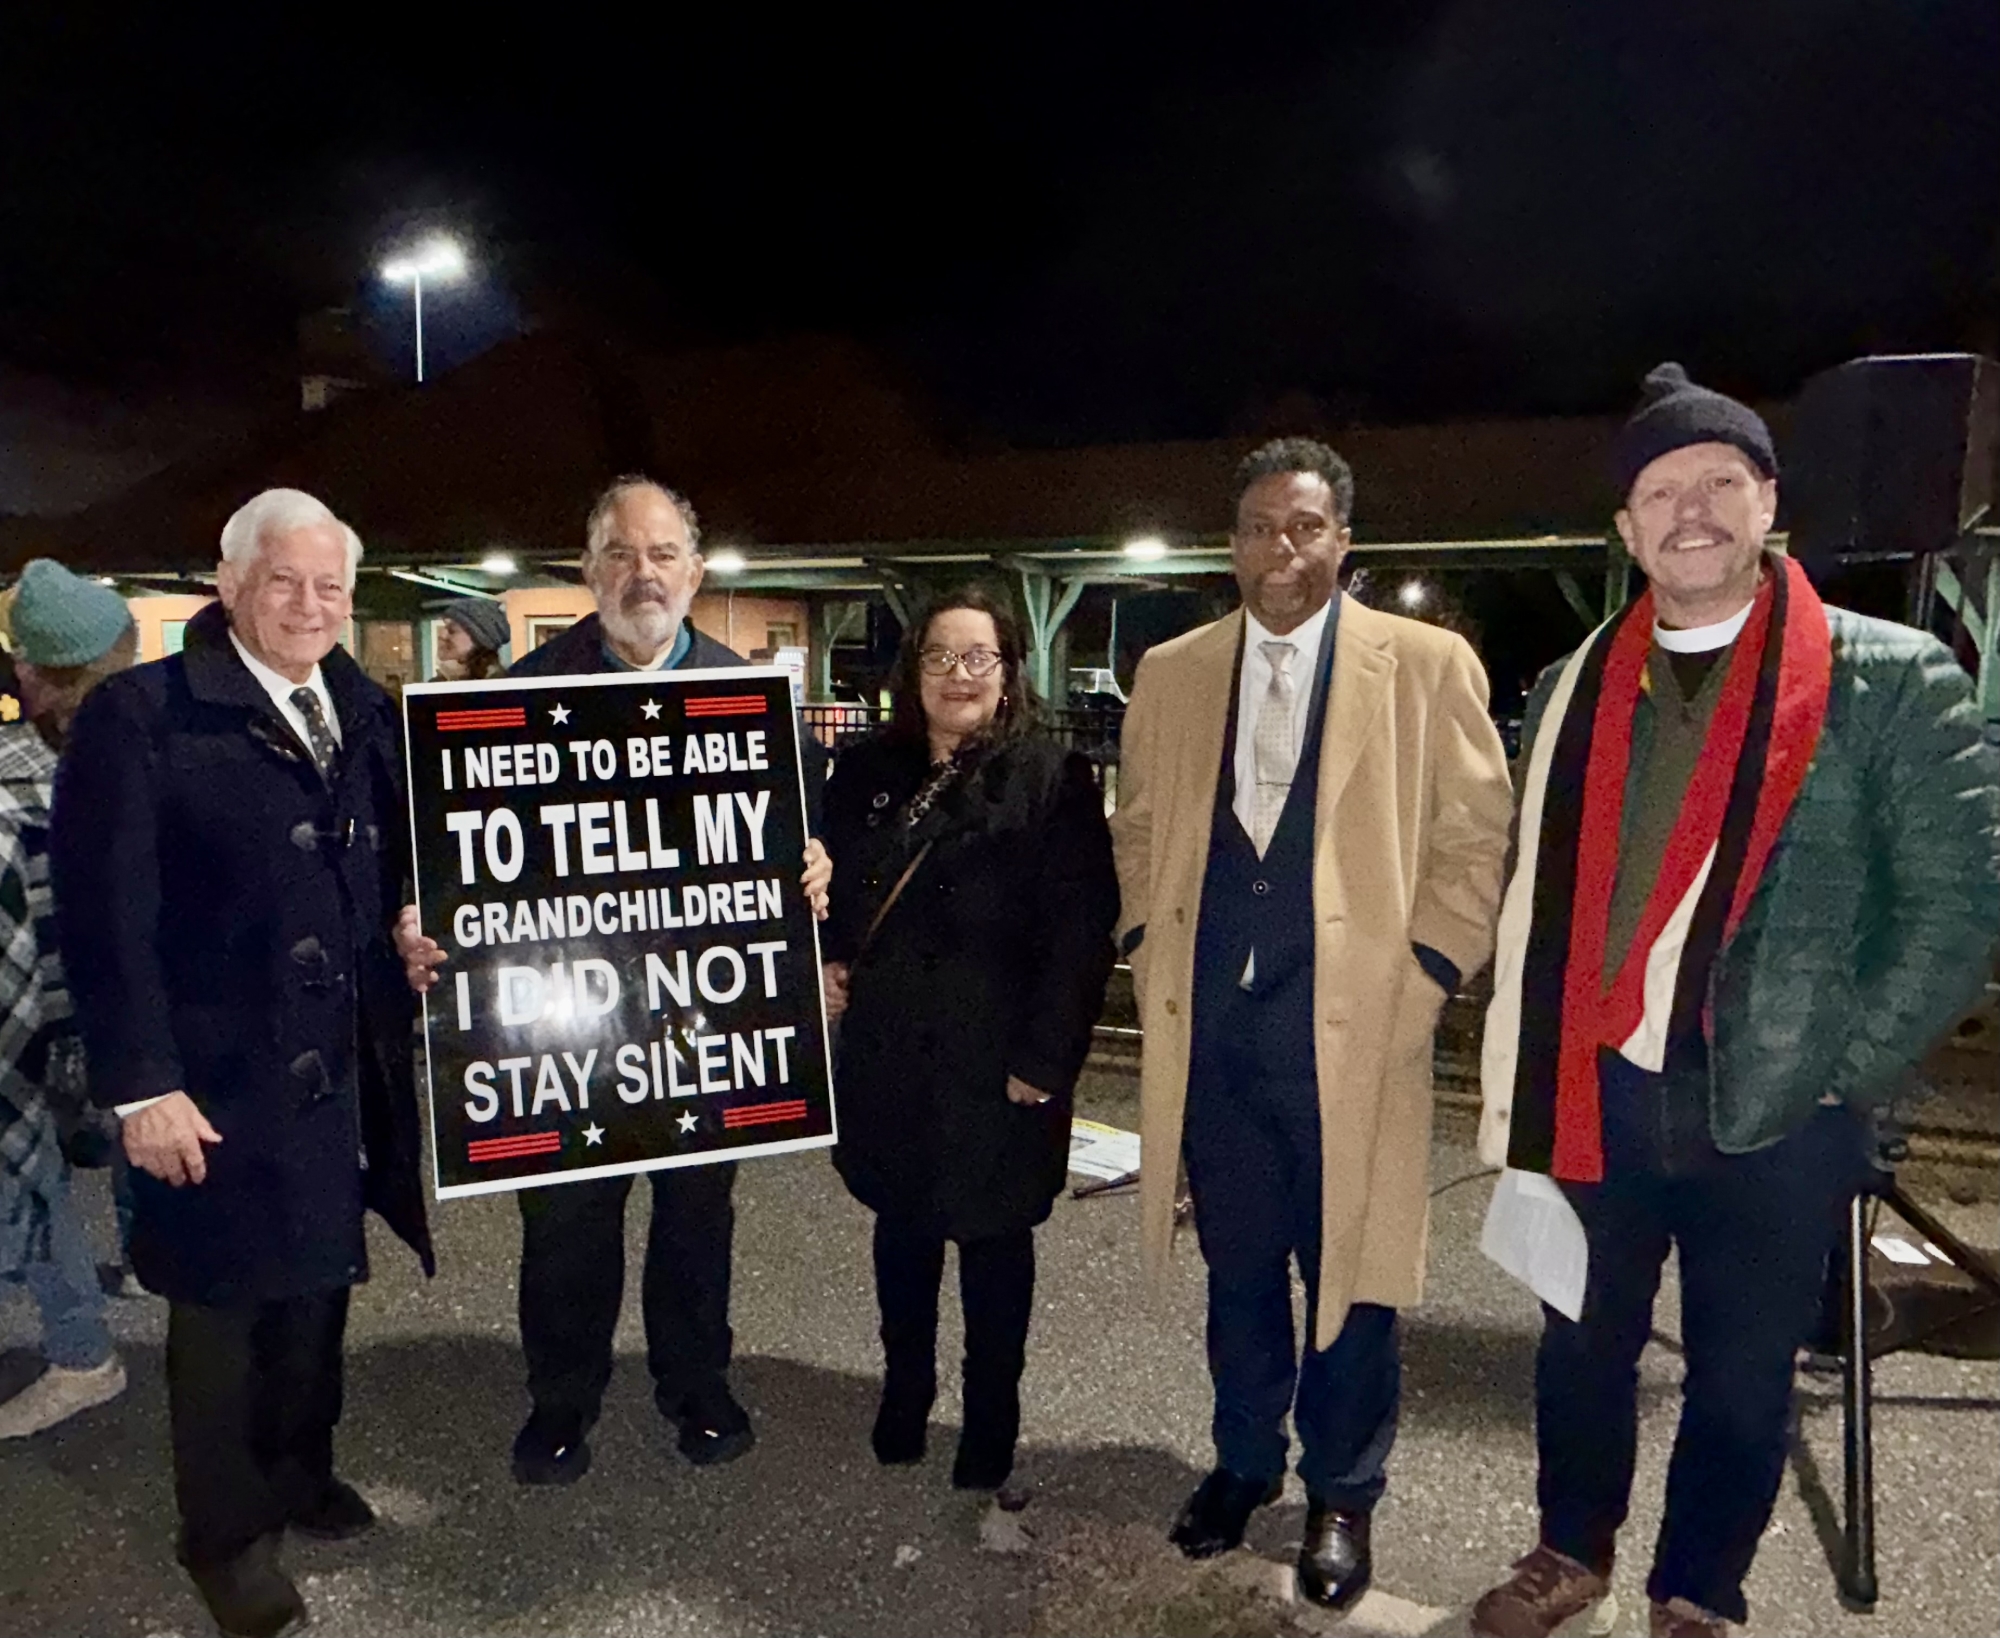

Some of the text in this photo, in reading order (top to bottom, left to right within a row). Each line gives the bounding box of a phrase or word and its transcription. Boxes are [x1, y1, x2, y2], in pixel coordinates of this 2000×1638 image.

[441, 730, 769, 790] I NEED TO BE ABLE
[446, 790, 771, 885] TO TELL MY
[453, 878, 783, 948] GRANDCHILDREN
[454, 940, 788, 1031] I DID NOT
[463, 1026, 796, 1123] STAY SILENT
